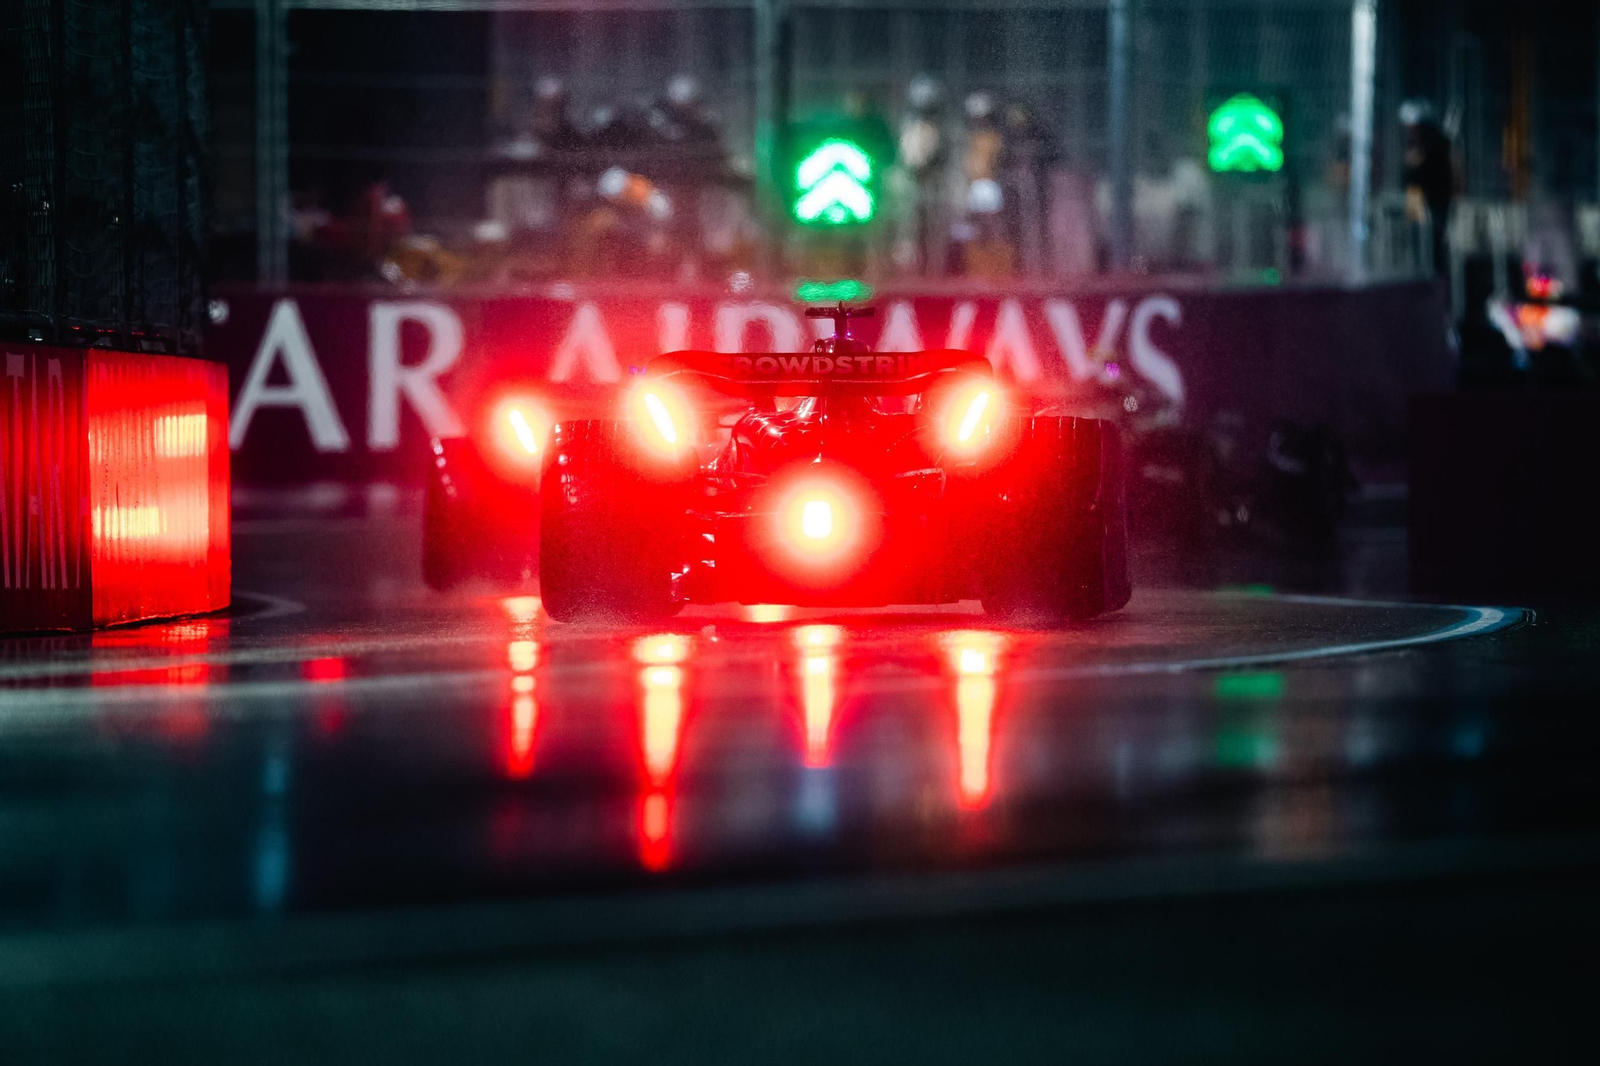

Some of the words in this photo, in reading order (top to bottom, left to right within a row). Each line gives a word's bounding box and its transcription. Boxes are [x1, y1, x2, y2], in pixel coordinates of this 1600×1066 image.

[229, 299, 467, 450] AR
[722, 355, 931, 376] ROWDSTRI
[0, 351, 68, 589] TAR
